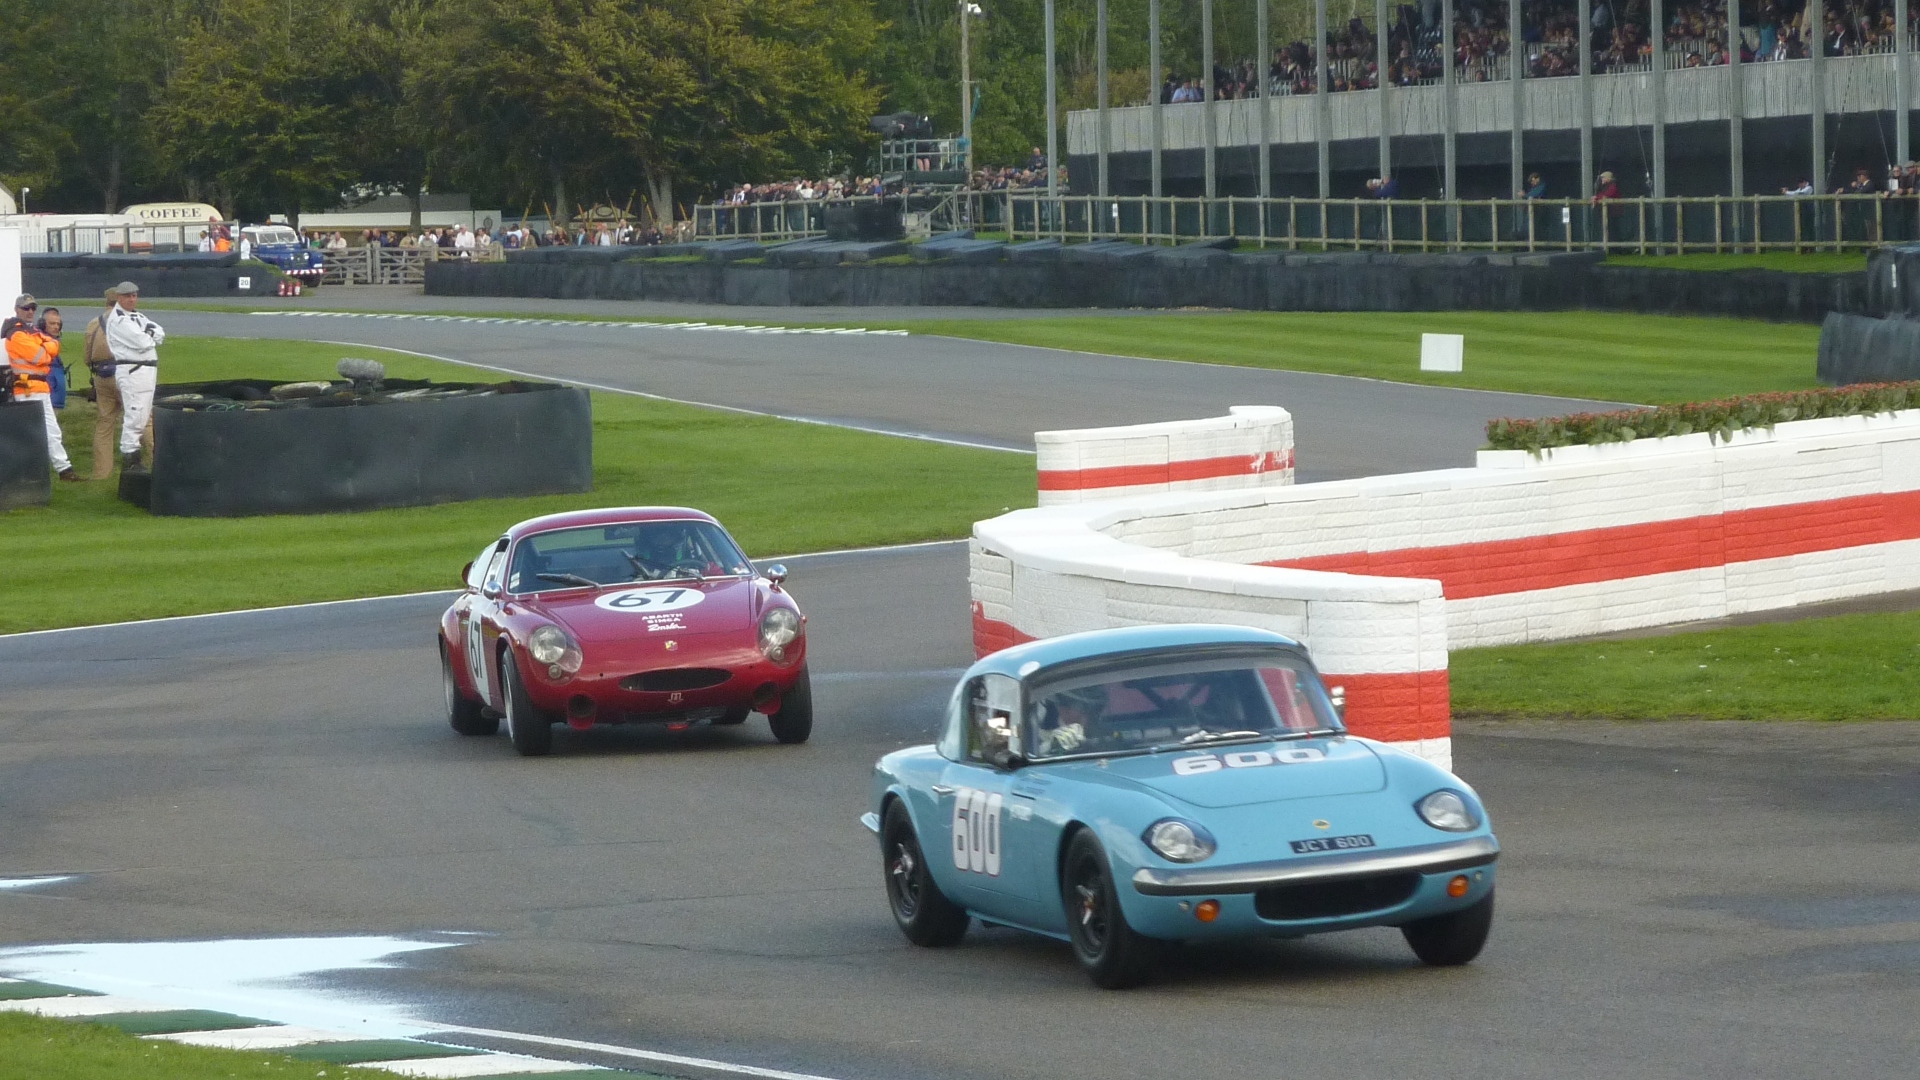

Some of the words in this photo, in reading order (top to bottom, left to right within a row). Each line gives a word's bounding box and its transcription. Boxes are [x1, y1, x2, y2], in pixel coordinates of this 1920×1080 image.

[140, 208, 201, 219] COFFEE
[609, 589, 687, 608] 67
[470, 620, 483, 679] 67
[1171, 748, 1326, 776] 600
[953, 787, 1004, 877] 600
[1297, 839, 1331, 853] JCT
[1335, 835, 1372, 849] 600
